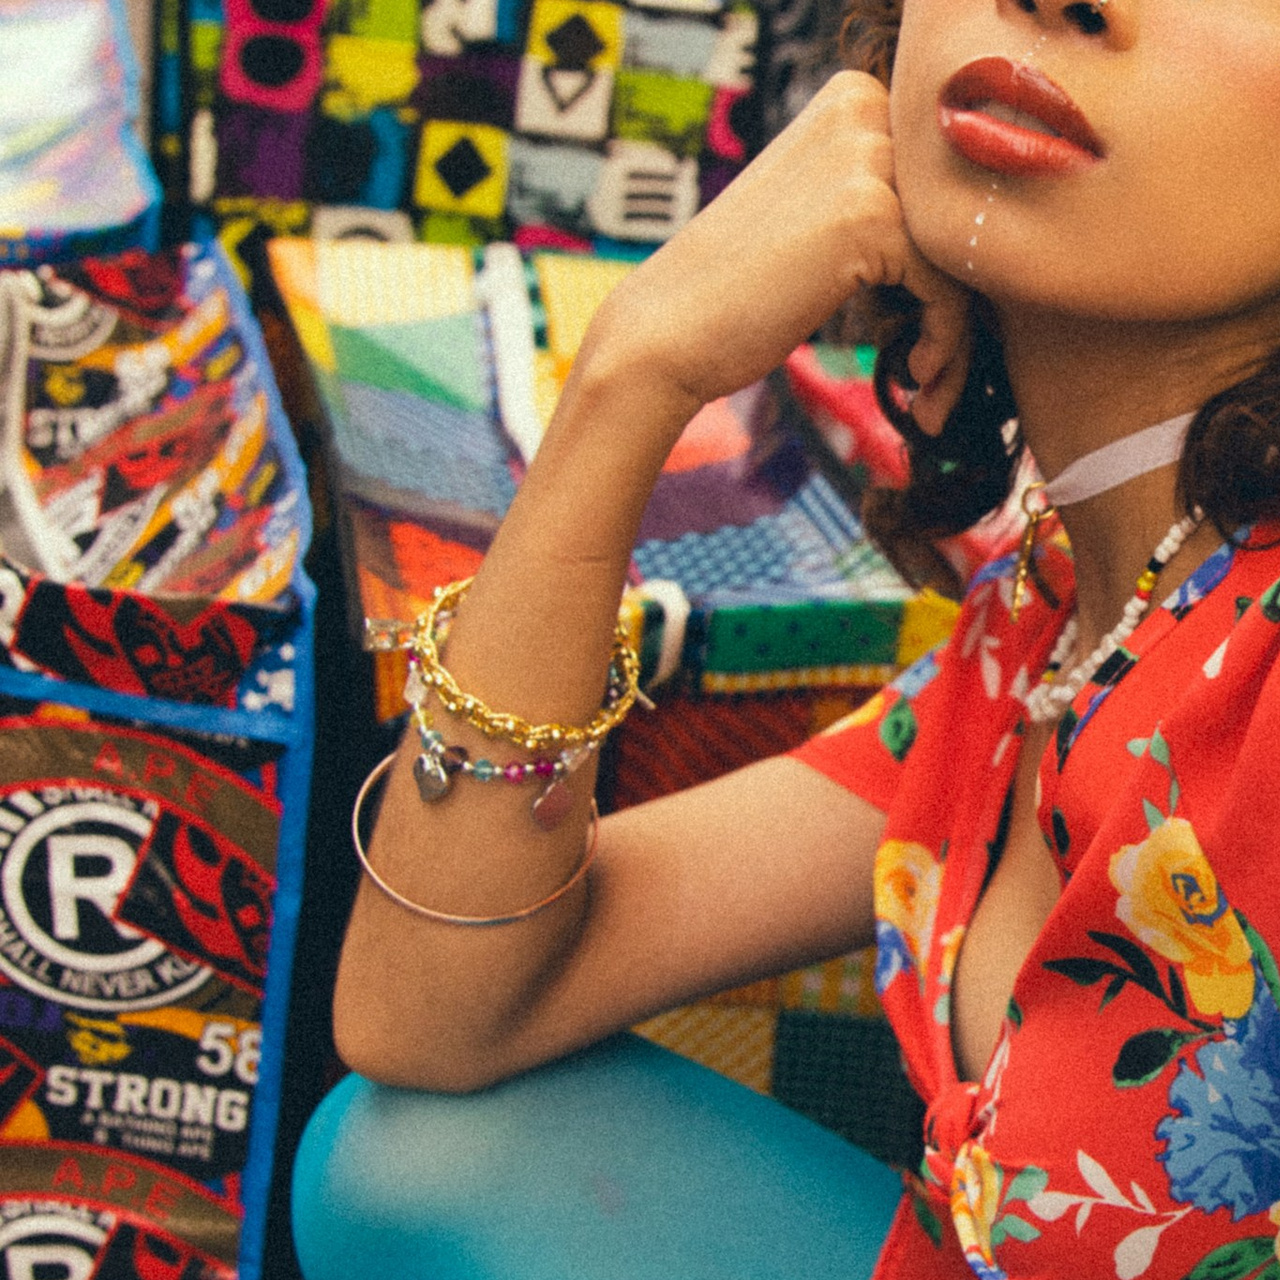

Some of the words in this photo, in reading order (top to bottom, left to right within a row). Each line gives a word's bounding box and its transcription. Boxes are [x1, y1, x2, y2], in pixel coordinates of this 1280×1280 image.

[47, 835, 142, 939] R
[59, 968, 160, 999] NEVER
[46, 1064, 250, 1133] STRONG
